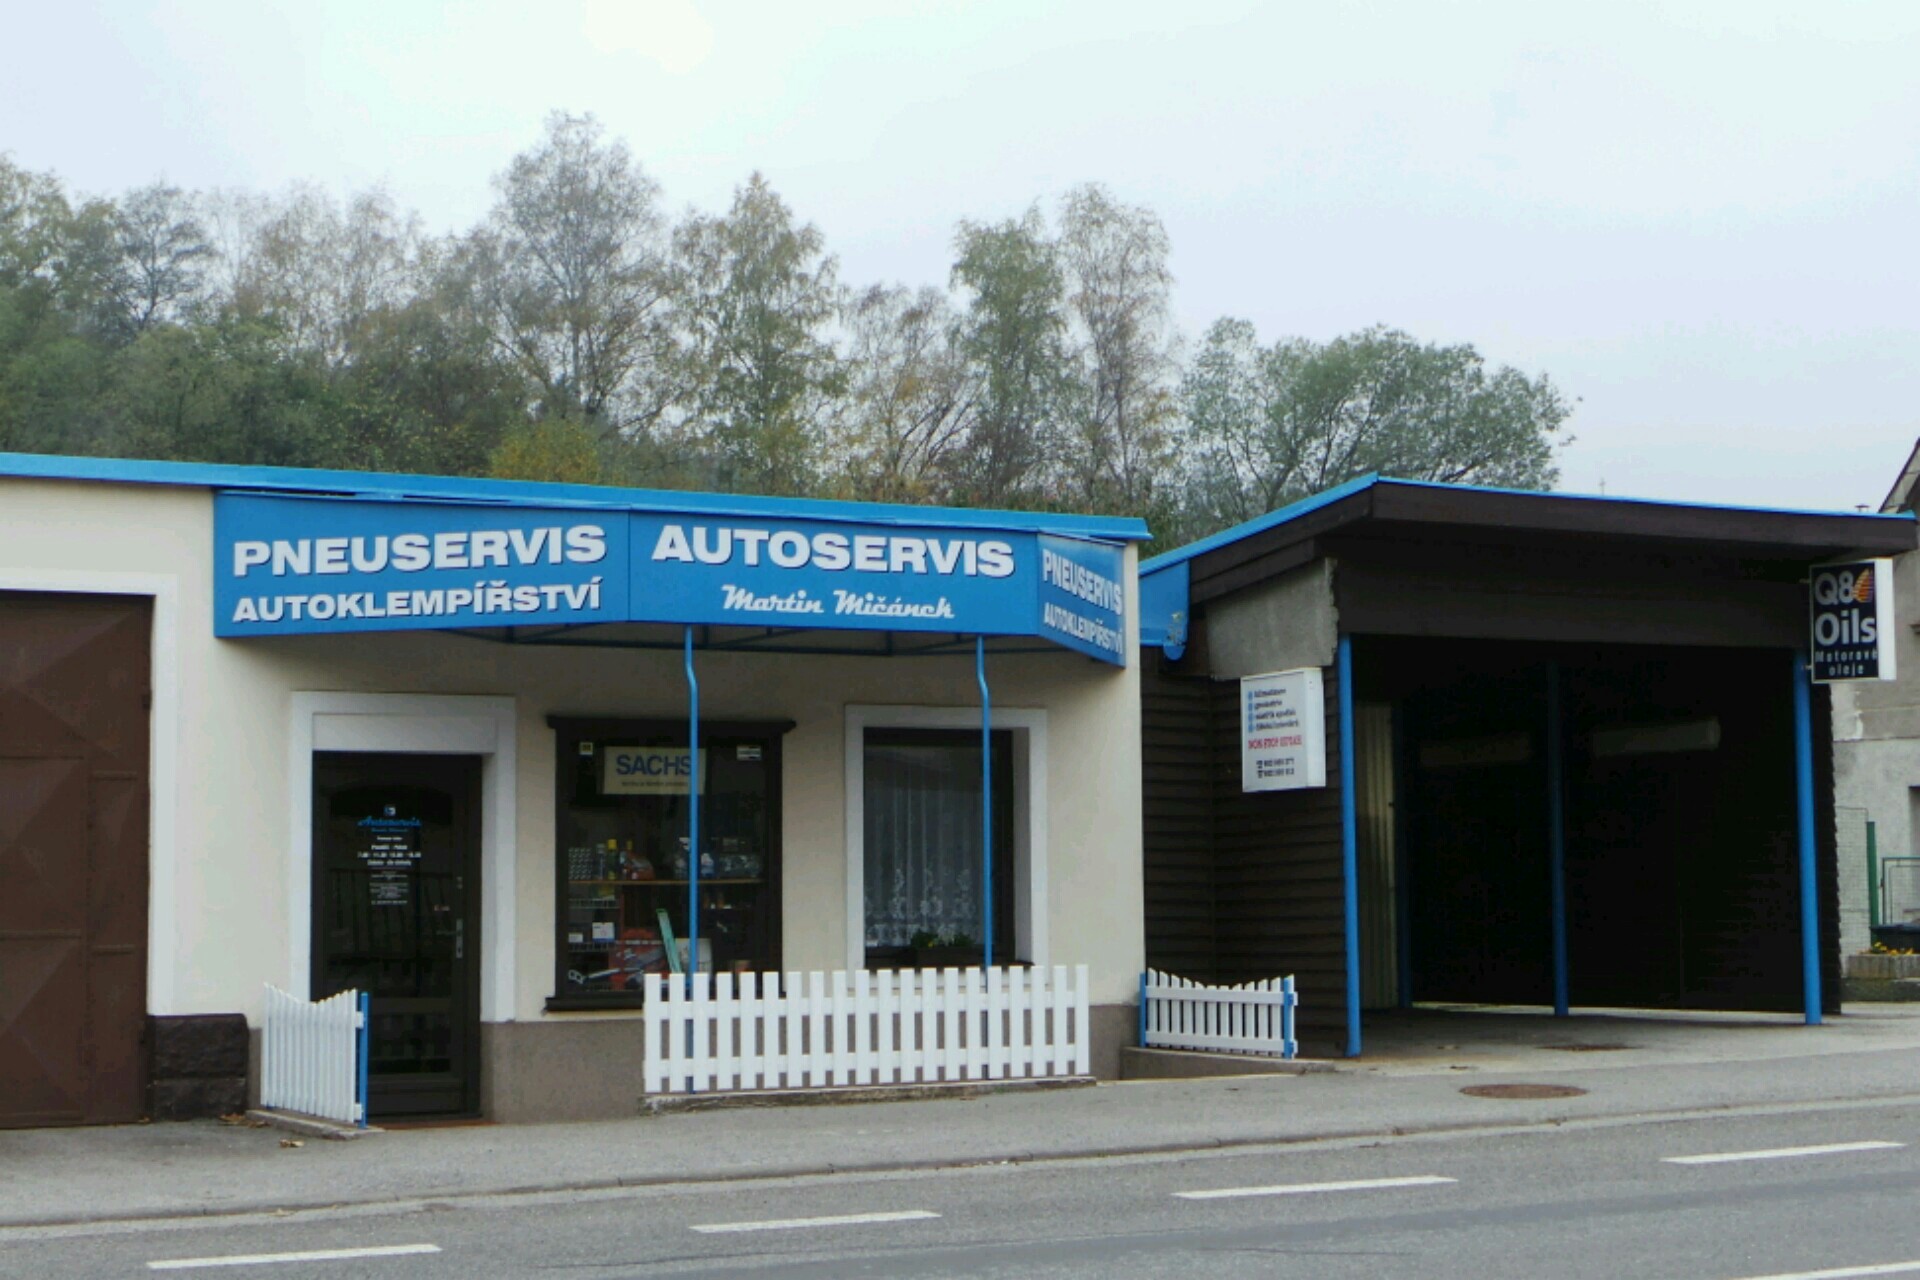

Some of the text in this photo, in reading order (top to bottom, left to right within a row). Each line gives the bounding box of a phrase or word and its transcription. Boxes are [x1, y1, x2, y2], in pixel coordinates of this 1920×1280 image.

[233, 525, 607, 577] PNEUSERVIS
[652, 525, 1016, 578] AUTOSERVIS
[232, 577, 602, 623] AUTOKLEMPÍŘSTVÍ
[721, 584, 824, 613] Martin
[1042, 548, 1122, 615] PNEUSERVIS
[1815, 571, 1854, 605] Q8
[1815, 608, 1877, 646] Oils
[616, 753, 691, 776] SACHS
